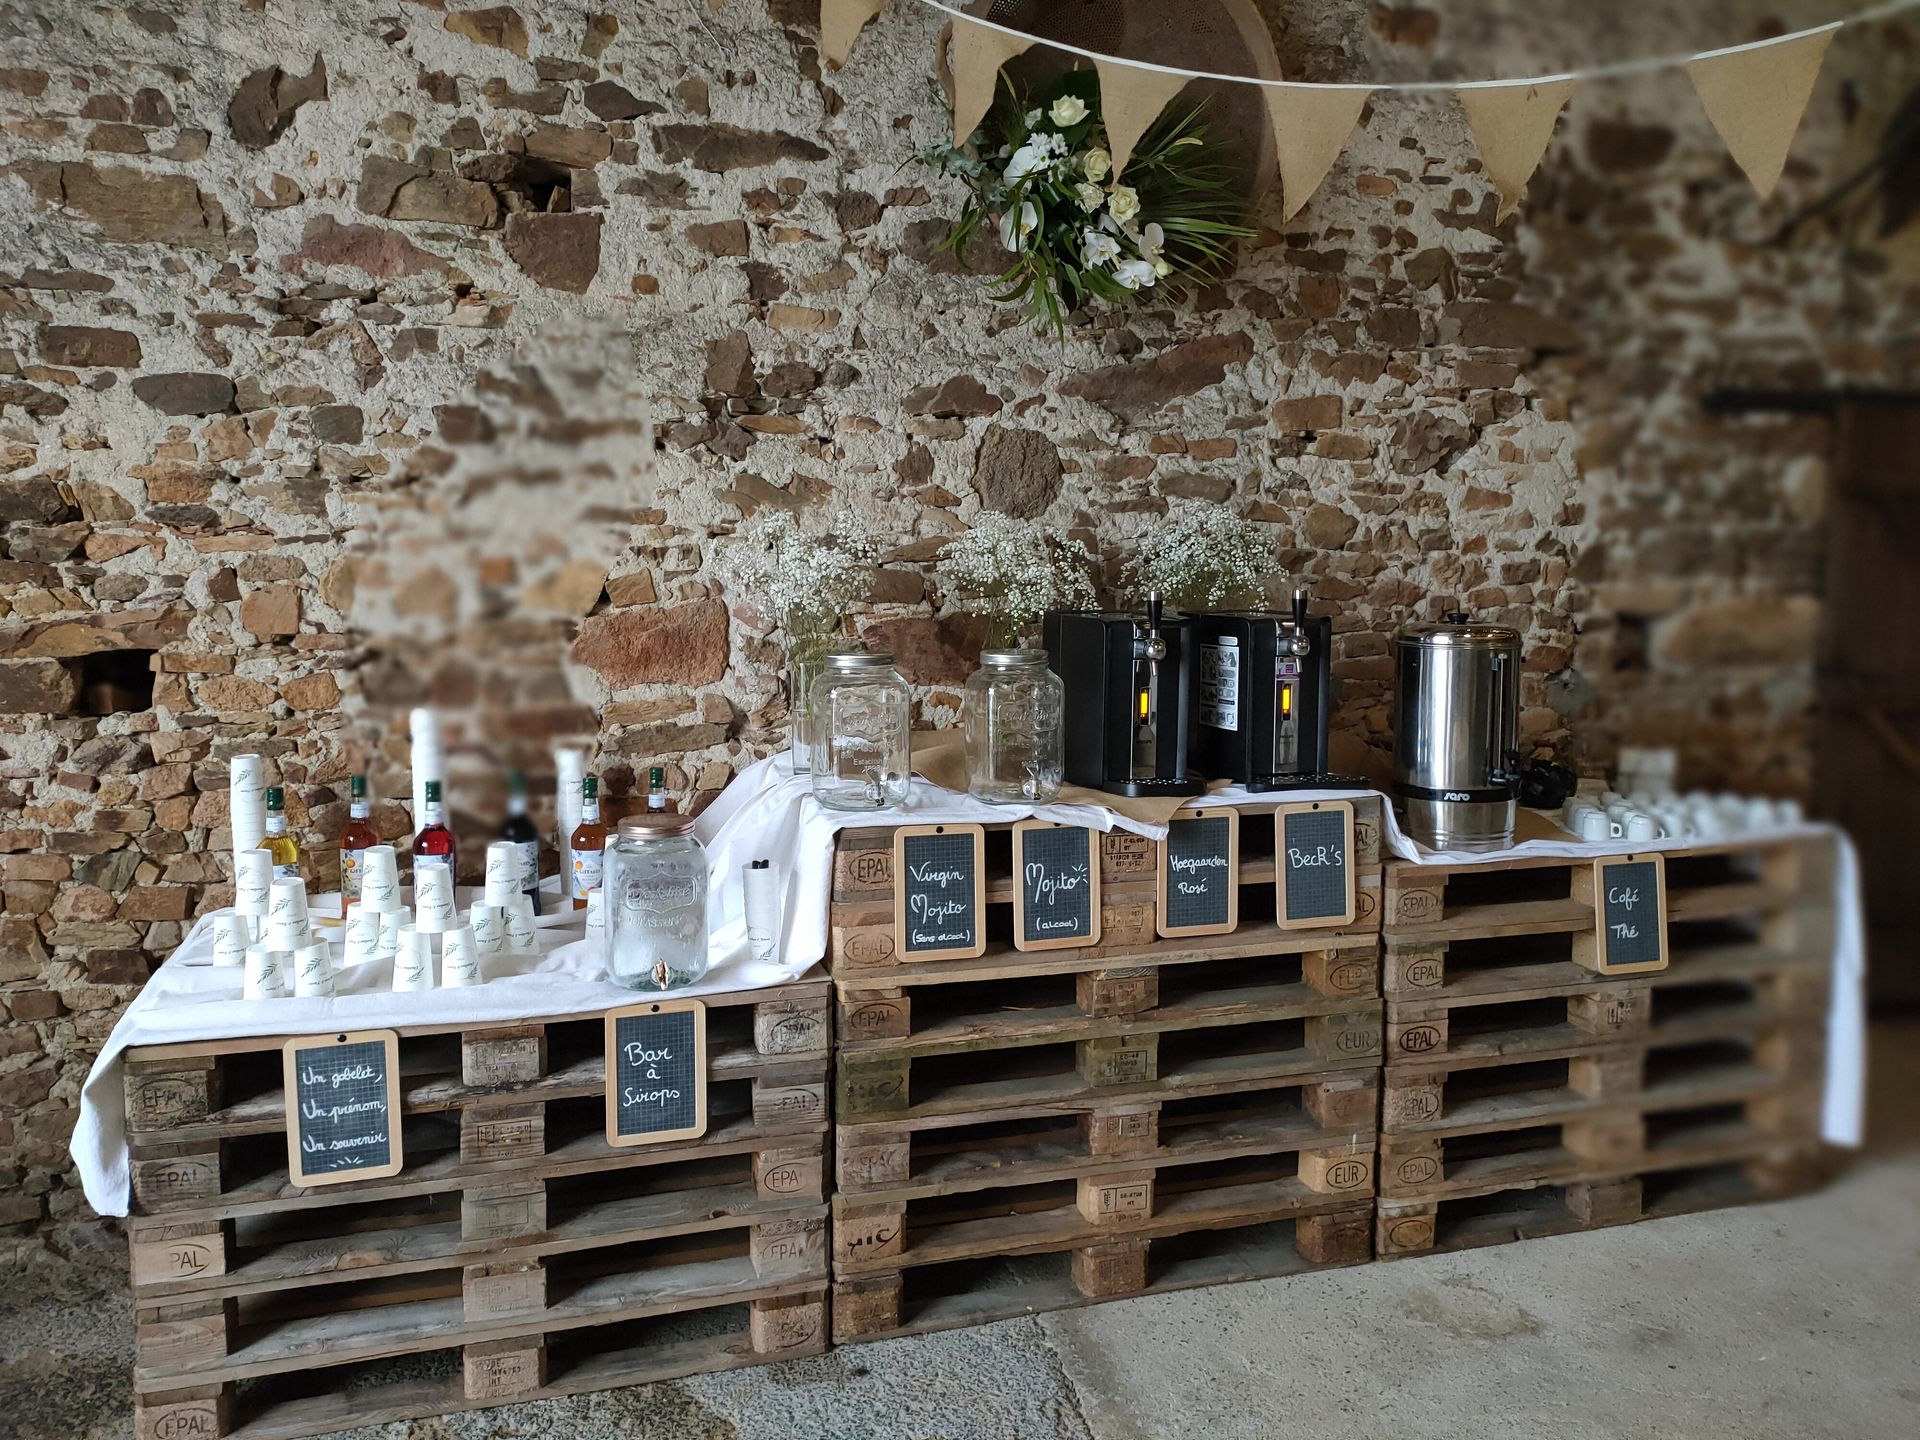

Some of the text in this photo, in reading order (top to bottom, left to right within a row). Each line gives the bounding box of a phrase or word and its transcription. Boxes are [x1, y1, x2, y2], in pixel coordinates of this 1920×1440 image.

[1443, 792, 1471, 801] saro
[1170, 854, 1228, 874] Hoegaarden
[909, 861, 965, 888] Virgin
[1025, 862, 1081, 905] Mojito
[1177, 878, 1209, 895] Rosé
[1609, 887, 1640, 911] Café
[910, 894, 967, 924] Mojito
[1036, 917, 1078, 931] (alcool)
[1610, 922, 1640, 939] Thé
[1412, 965, 1442, 981] EPAL
[1345, 1030, 1370, 1049] EUR
[1406, 1030, 1434, 1048] EPAL
[624, 1042, 673, 1066] Bar
[302, 1064, 382, 1089] Un gobelet,
[646, 1063, 661, 1080] à
[622, 1087, 680, 1107] Sirops
[302, 1097, 387, 1124] Un prénom,
[302, 1130, 388, 1152] Un souvenir
[1335, 1165, 1359, 1184] EUR
[1403, 1161, 1431, 1180] EPAL
